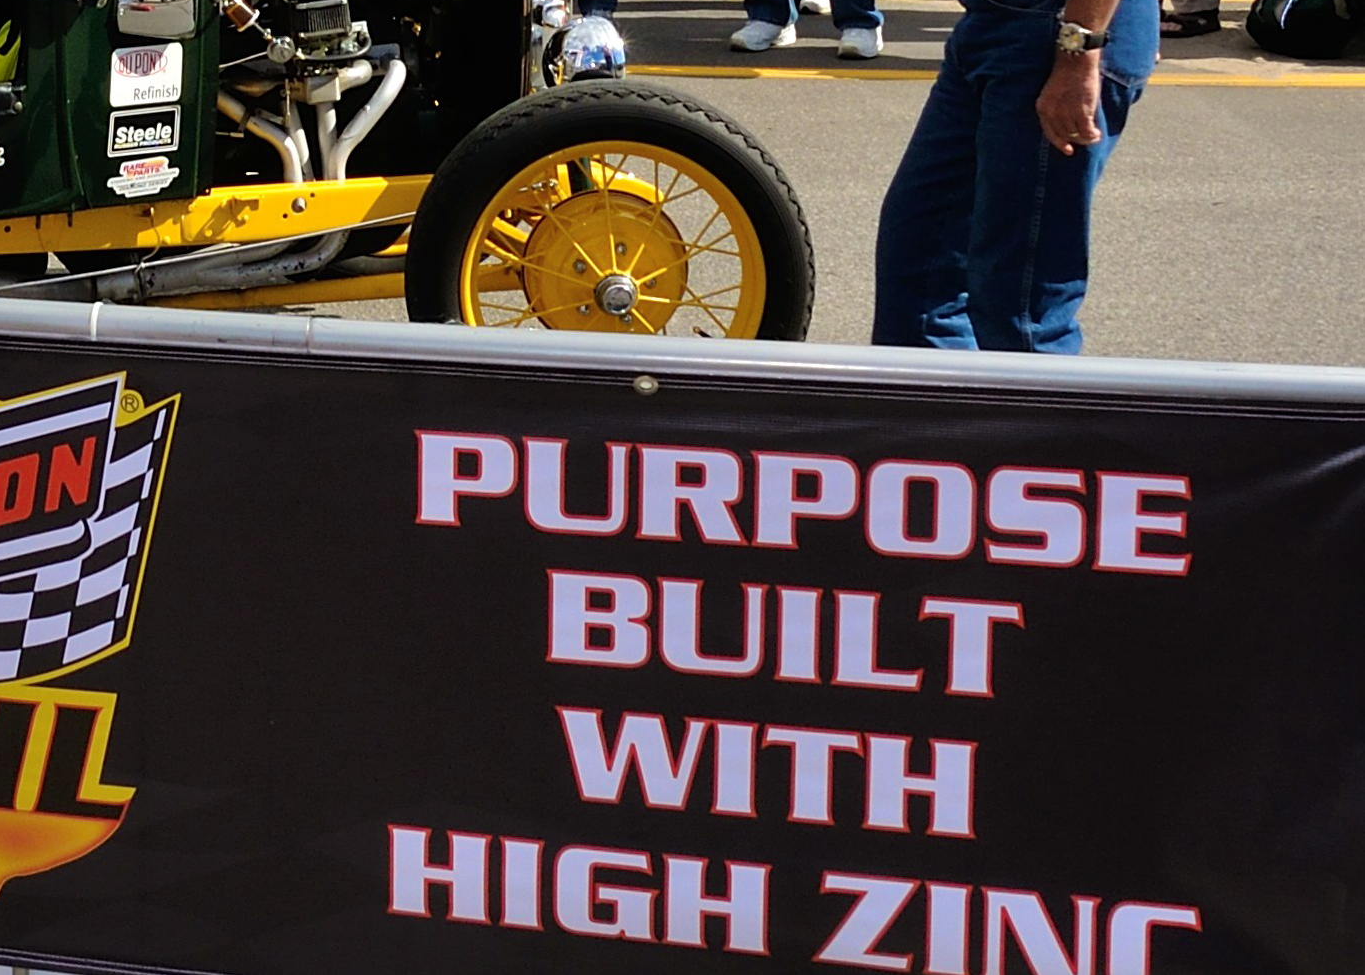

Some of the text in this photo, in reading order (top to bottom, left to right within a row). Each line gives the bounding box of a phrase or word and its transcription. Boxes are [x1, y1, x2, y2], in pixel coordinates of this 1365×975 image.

[115, 122, 173, 144] Steele
[133, 84, 180, 101] Refinish
[415, 429, 1192, 576] PURPOSE
[546, 568, 1025, 697] BUILT
[555, 705, 979, 839] WITH
[387, 823, 773, 957] HIGH
[812, 870, 1203, 975] ZINC
